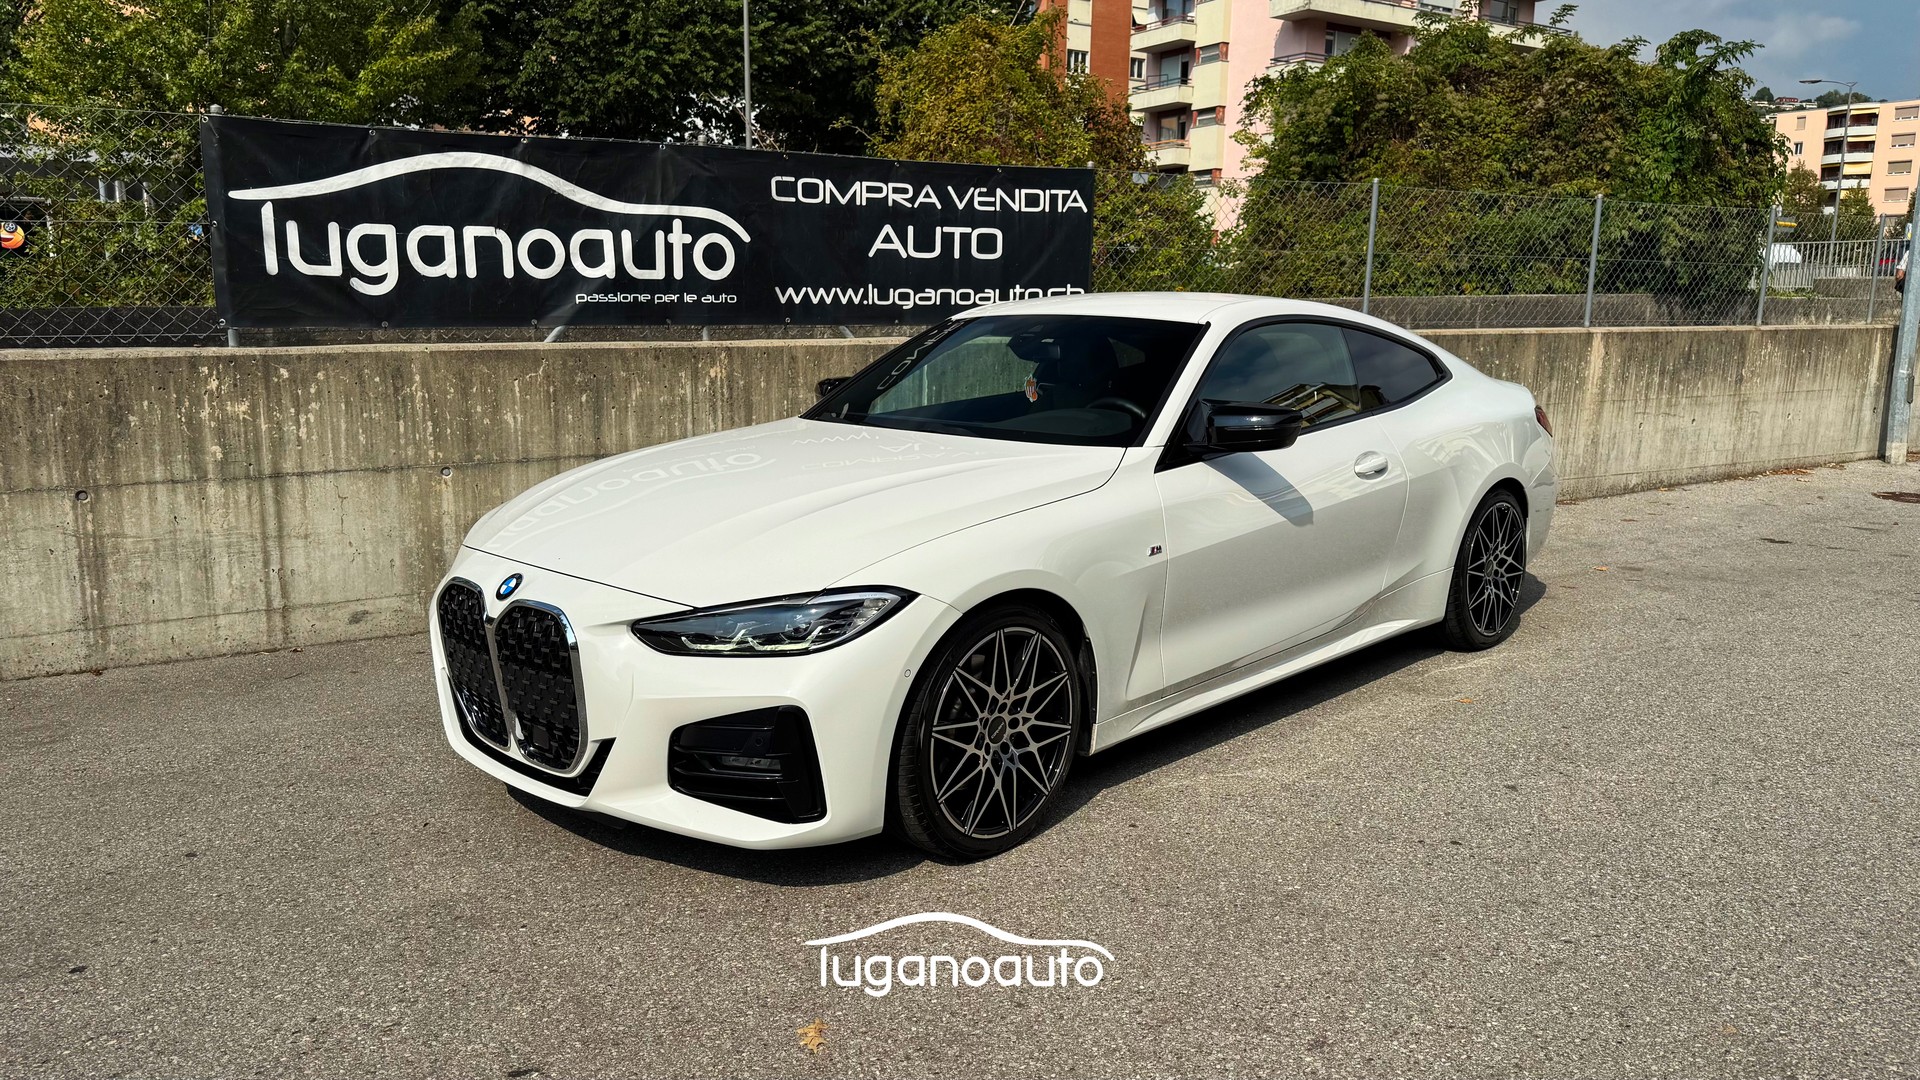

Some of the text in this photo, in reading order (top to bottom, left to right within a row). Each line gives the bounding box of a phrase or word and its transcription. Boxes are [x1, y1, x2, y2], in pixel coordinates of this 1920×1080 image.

[770, 175, 1088, 214] COMPRA VENDITA
[260, 200, 738, 296] luganoauto
[867, 223, 1003, 260] AUTO
[575, 291, 738, 305] passione per le auto
